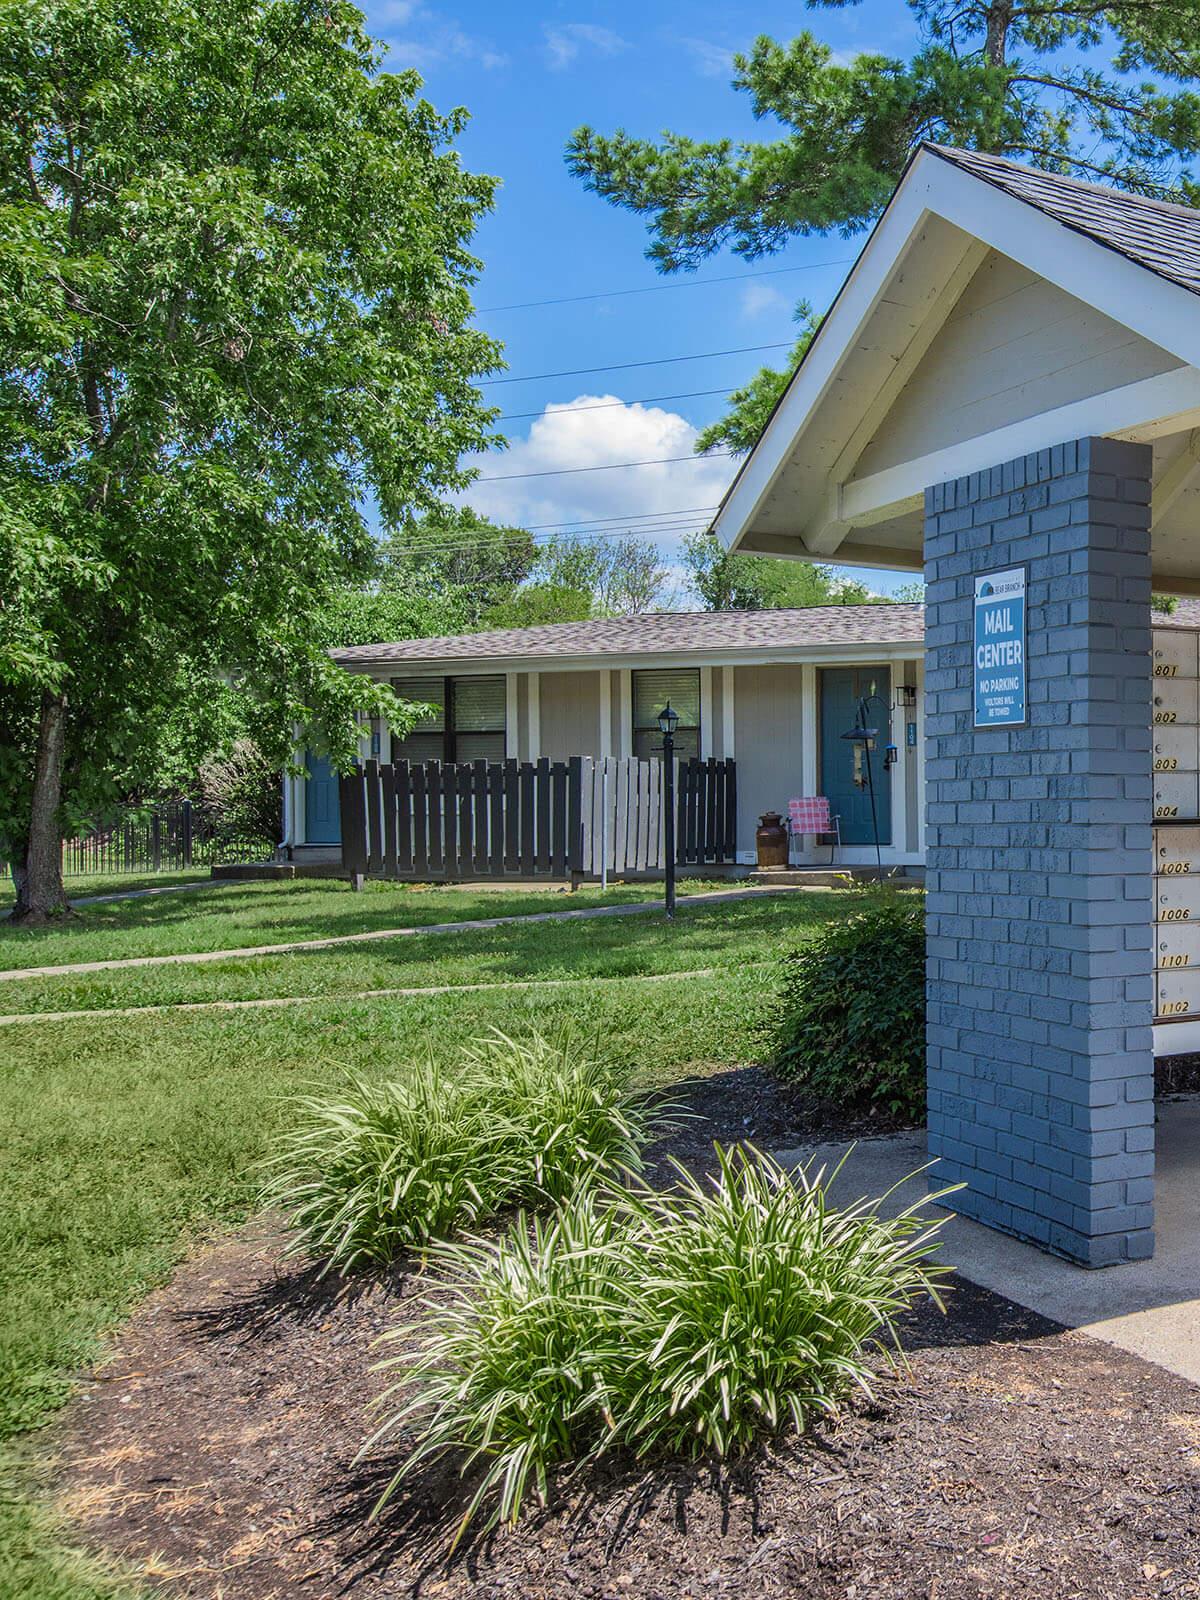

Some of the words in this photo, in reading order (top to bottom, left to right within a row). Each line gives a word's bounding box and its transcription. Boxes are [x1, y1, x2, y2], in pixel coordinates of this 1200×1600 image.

[984, 607, 1014, 635] MAIL
[977, 640, 1022, 670] CENTER
[1155, 666, 1176, 676] 801
[980, 680, 990, 694] NO
[990, 677, 1019, 692] PARKING
[1155, 713, 1176, 723] 802
[1155, 759, 1177, 769] 803
[1156, 807, 1178, 817] 804
[1161, 863, 1190, 874] 1005
[1161, 909, 1190, 920] 1006
[1161, 955, 1189, 966] 1101
[1162, 1002, 1189, 1014] 1102
